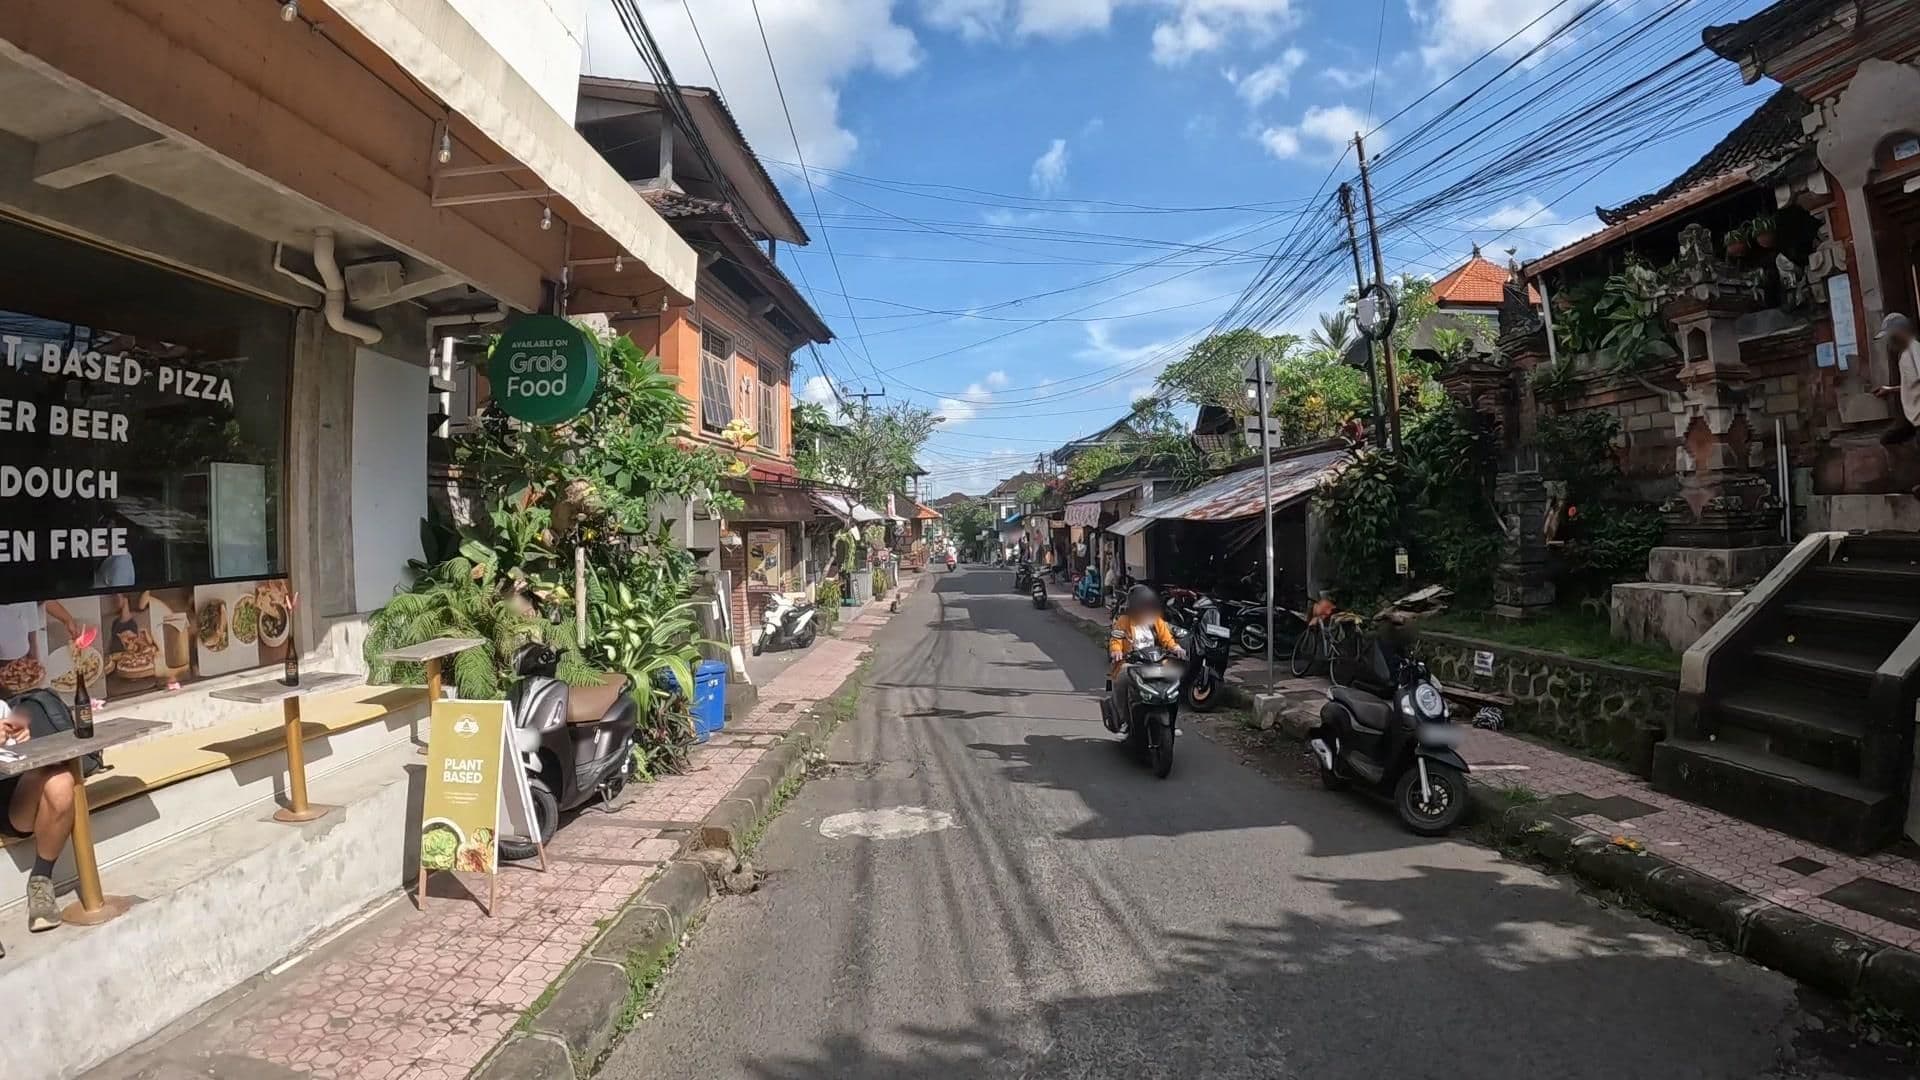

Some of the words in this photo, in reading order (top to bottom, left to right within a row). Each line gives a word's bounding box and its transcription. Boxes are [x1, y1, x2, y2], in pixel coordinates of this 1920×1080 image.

[511, 340, 554, 348] AVAILABLE
[555, 339, 568, 347] ON
[509, 350, 567, 373] Grab
[158, 366, 234, 405] PIZZA
[506, 372, 567, 397] Food
[49, 405, 129, 443] BEER
[0, 465, 118, 499] DOUGH
[50, 527, 129, 560] FREE
[444, 758, 484, 771] PLANT
[443, 771, 484, 784] BASED
